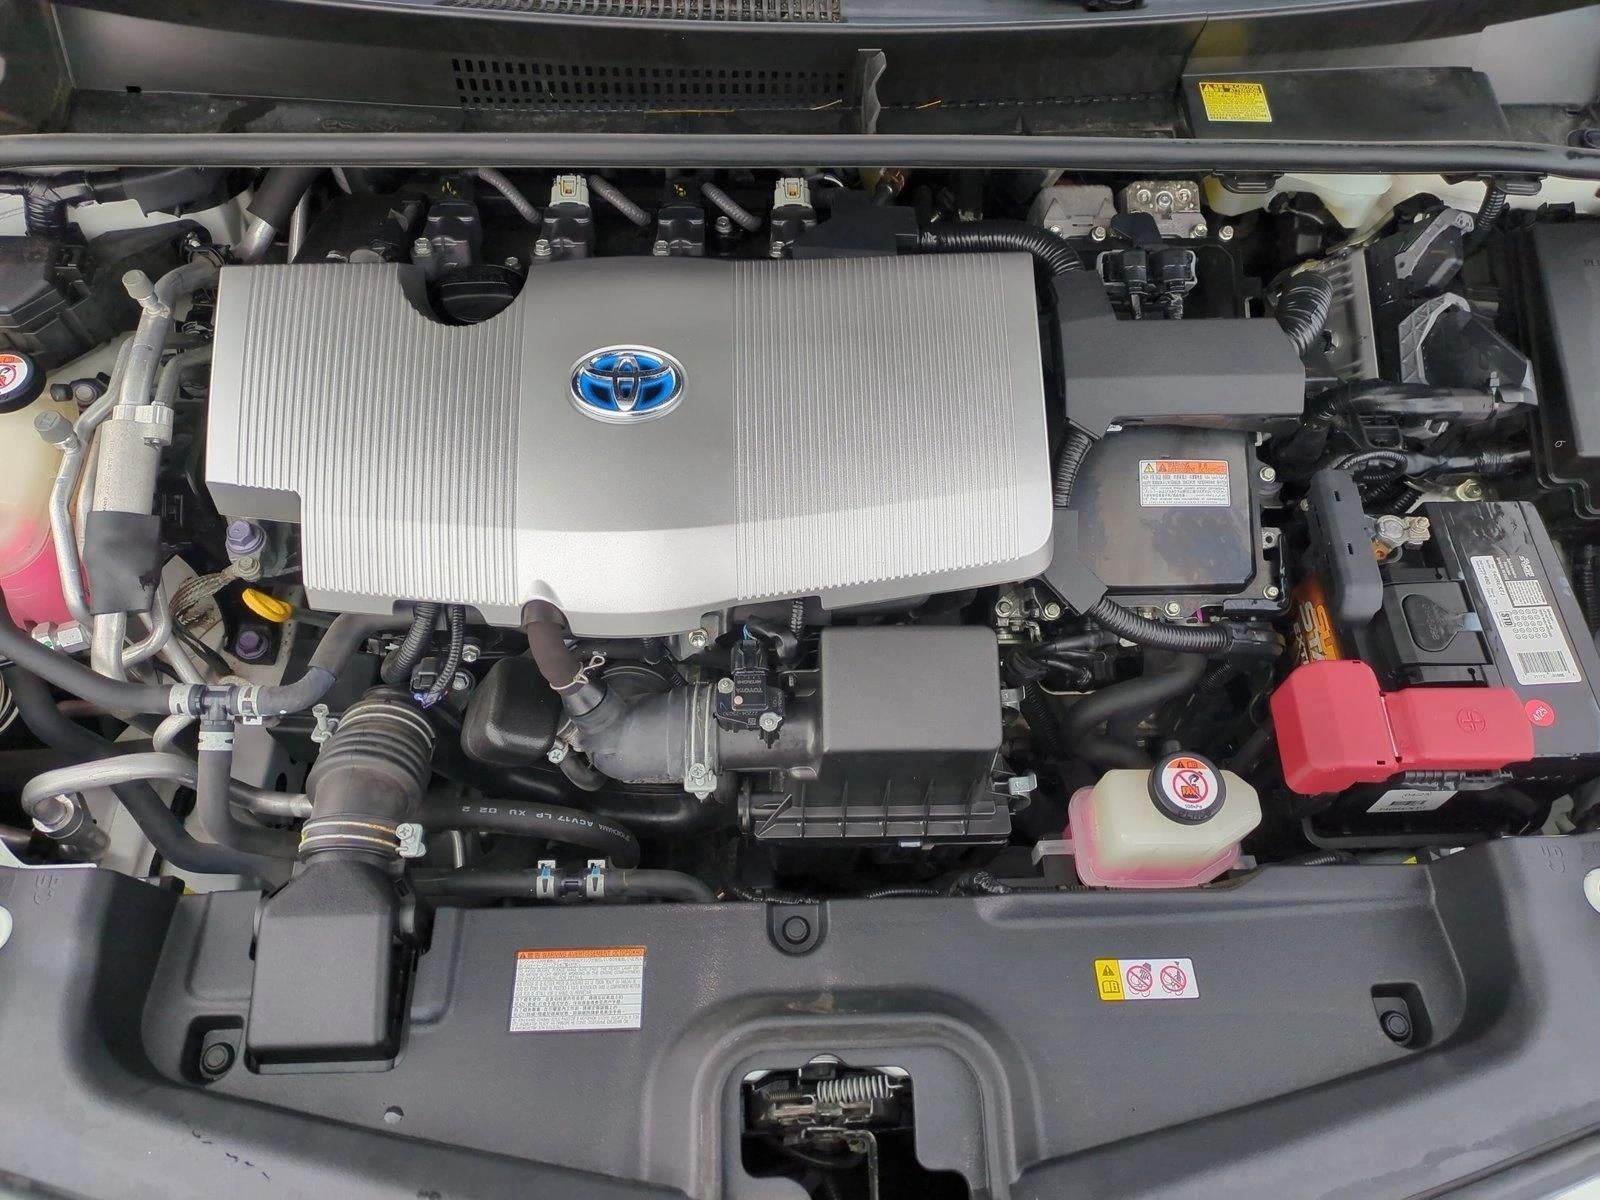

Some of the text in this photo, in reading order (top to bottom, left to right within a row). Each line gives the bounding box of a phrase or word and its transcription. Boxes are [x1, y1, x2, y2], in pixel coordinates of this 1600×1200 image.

[1501, 613, 1513, 626] STD
[509, 809, 526, 817] XU
[557, 815, 594, 827] ACV17
